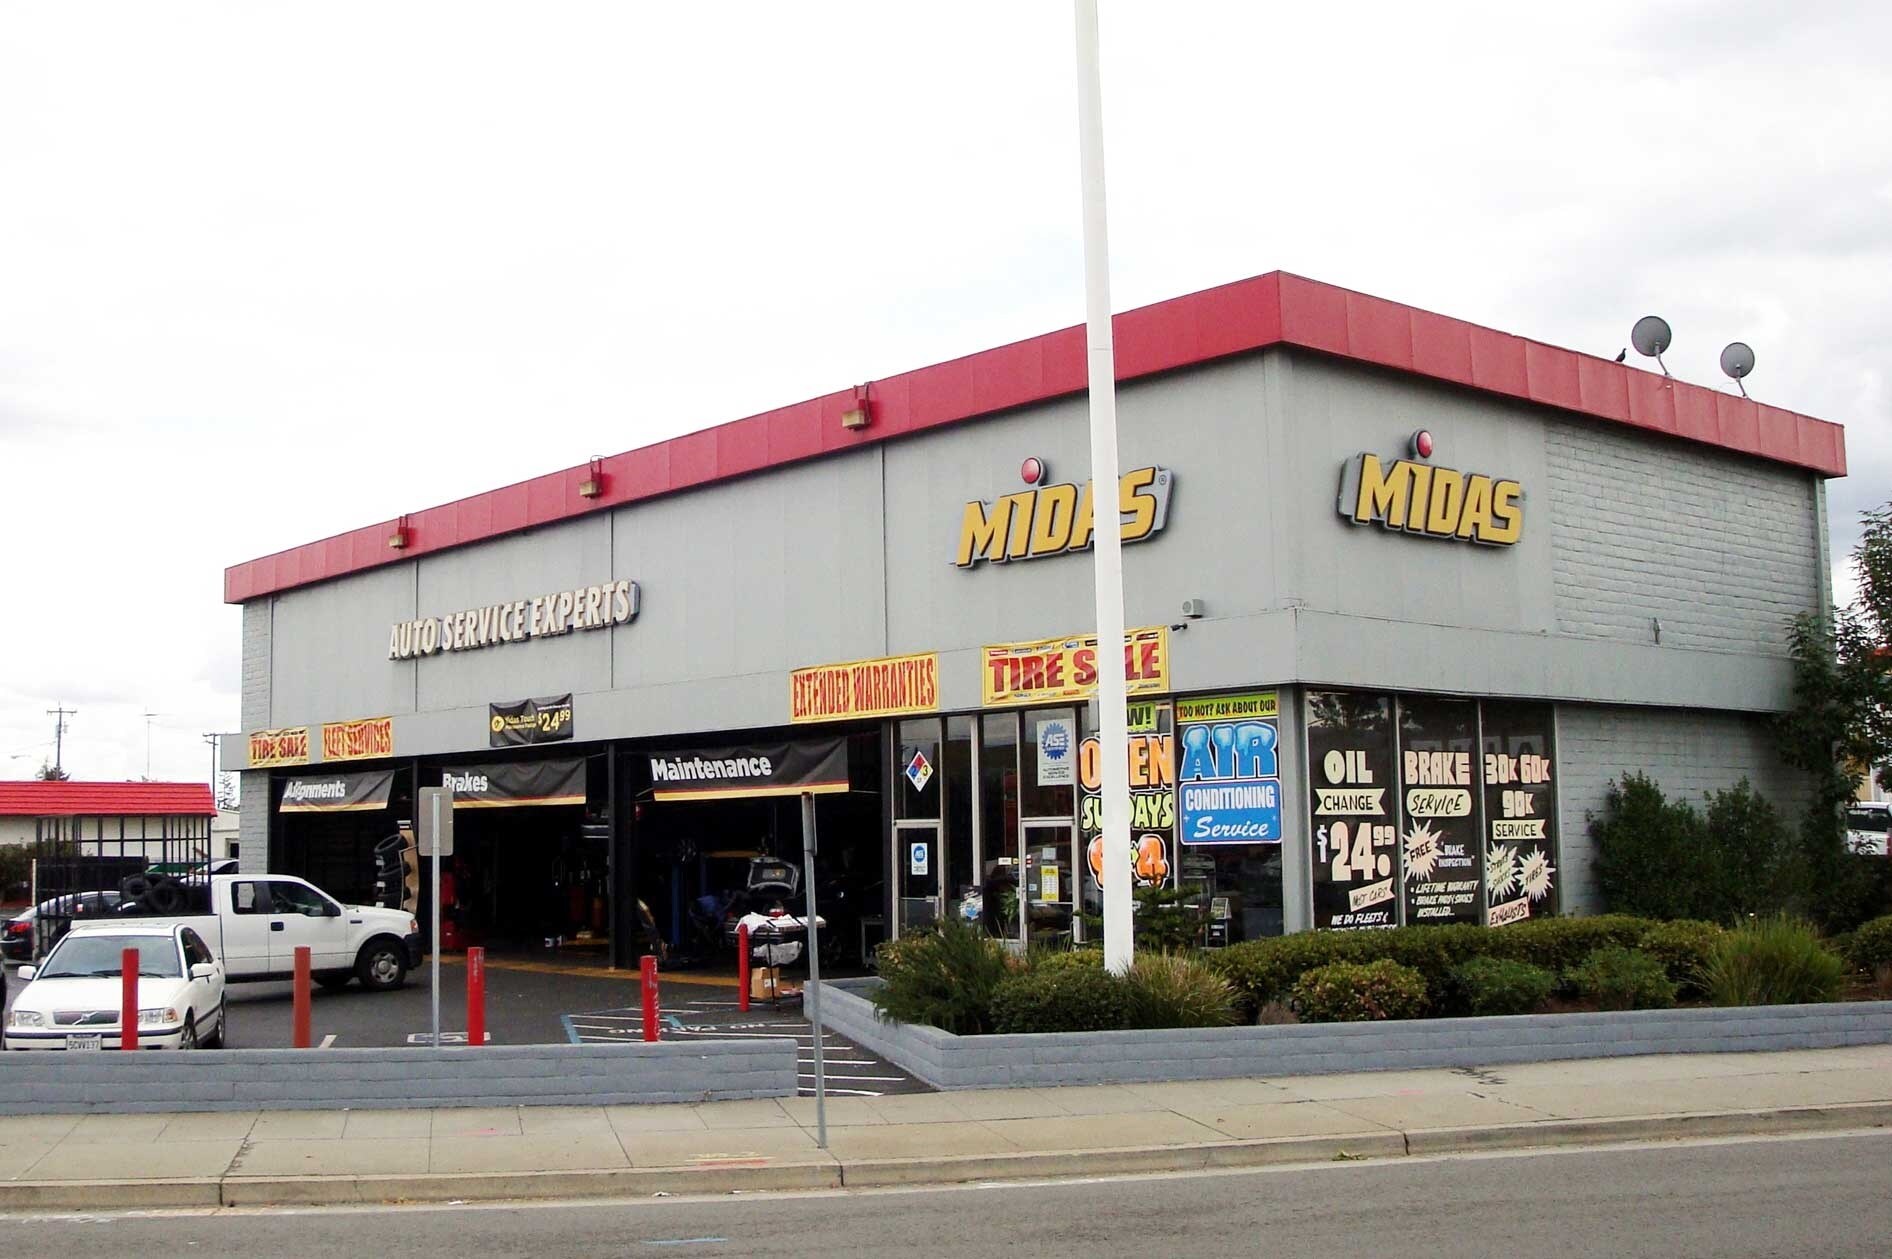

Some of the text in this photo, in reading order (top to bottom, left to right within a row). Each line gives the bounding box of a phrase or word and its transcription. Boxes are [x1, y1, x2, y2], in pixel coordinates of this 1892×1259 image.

[1355, 453, 1522, 545] MIDAS
[388, 580, 633, 660] AUTO SERVICE EXPERTS
[989, 642, 1160, 692] TIRE SLE
[793, 658, 936, 717] EXTENDED WARRANTIES
[1180, 699, 1276, 717] TOO HOT? ASK ABOUT OUR
[251, 734, 307, 760] TIRE SALE
[347, 720, 391, 756] SERVICES
[1045, 733, 1065, 747] ASE
[1080, 735, 1173, 791] OEN
[1180, 721, 1277, 781] AIR
[650, 756, 772, 782] Maintenance
[922, 764, 928, 776] 3
[1324, 750, 1373, 784] OIL
[1404, 750, 1470, 785] BRAKE
[1485, 753, 1550, 784] 30K 60K
[283, 780, 346, 801] Alignments
[443, 771, 488, 792] Brakes
[1081, 792, 1174, 830] SUAYS
[1185, 786, 1275, 811] CONDITIONING
[1324, 795, 1374, 811] CHANGE
[1411, 793, 1464, 815] SERVICE
[1502, 790, 1535, 817] 90K
[1194, 815, 1269, 838] Service
[1495, 823, 1537, 837] SERVICE
[1410, 840, 1432, 863] FREE
[1525, 863, 1543, 886] TIRES
[1415, 881, 1447, 894] LIFETIME
[1331, 914, 1344, 926] WE
[1344, 914, 1354, 925] DO
[1355, 911, 1383, 925] FLEETS
[1490, 902, 1527, 926] EXHAUSTS
